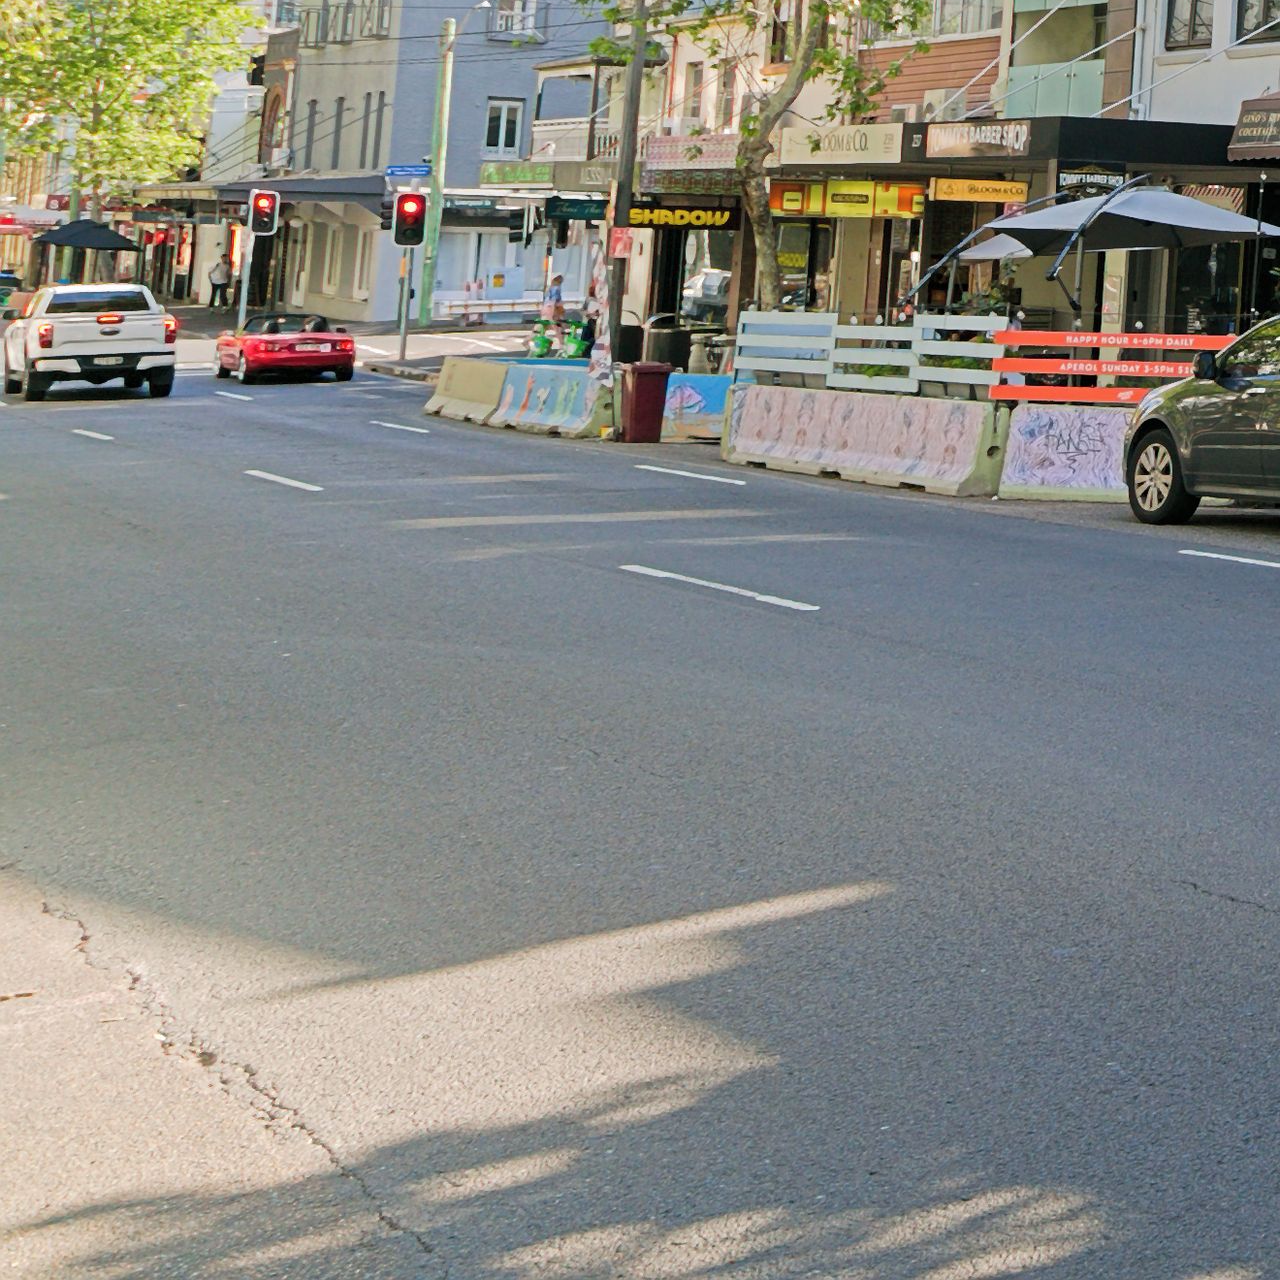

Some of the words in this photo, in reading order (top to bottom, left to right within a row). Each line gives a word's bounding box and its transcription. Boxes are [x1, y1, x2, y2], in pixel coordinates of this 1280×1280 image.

[931, 127, 967, 152] TOMMY'S
[969, 126, 1002, 144] BARBER
[1002, 126, 1028, 151] SHOP
[629, 208, 730, 226] SHADOW
[1066, 335, 1097, 344] HAPPY
[1102, 336, 1129, 345] HOUR
[1133, 337, 1162, 345] 4-6PM
[1166, 338, 1194, 346] DAILY
[1060, 363, 1097, 372] APEROL
[1102, 364, 1139, 373] SUNDAY
